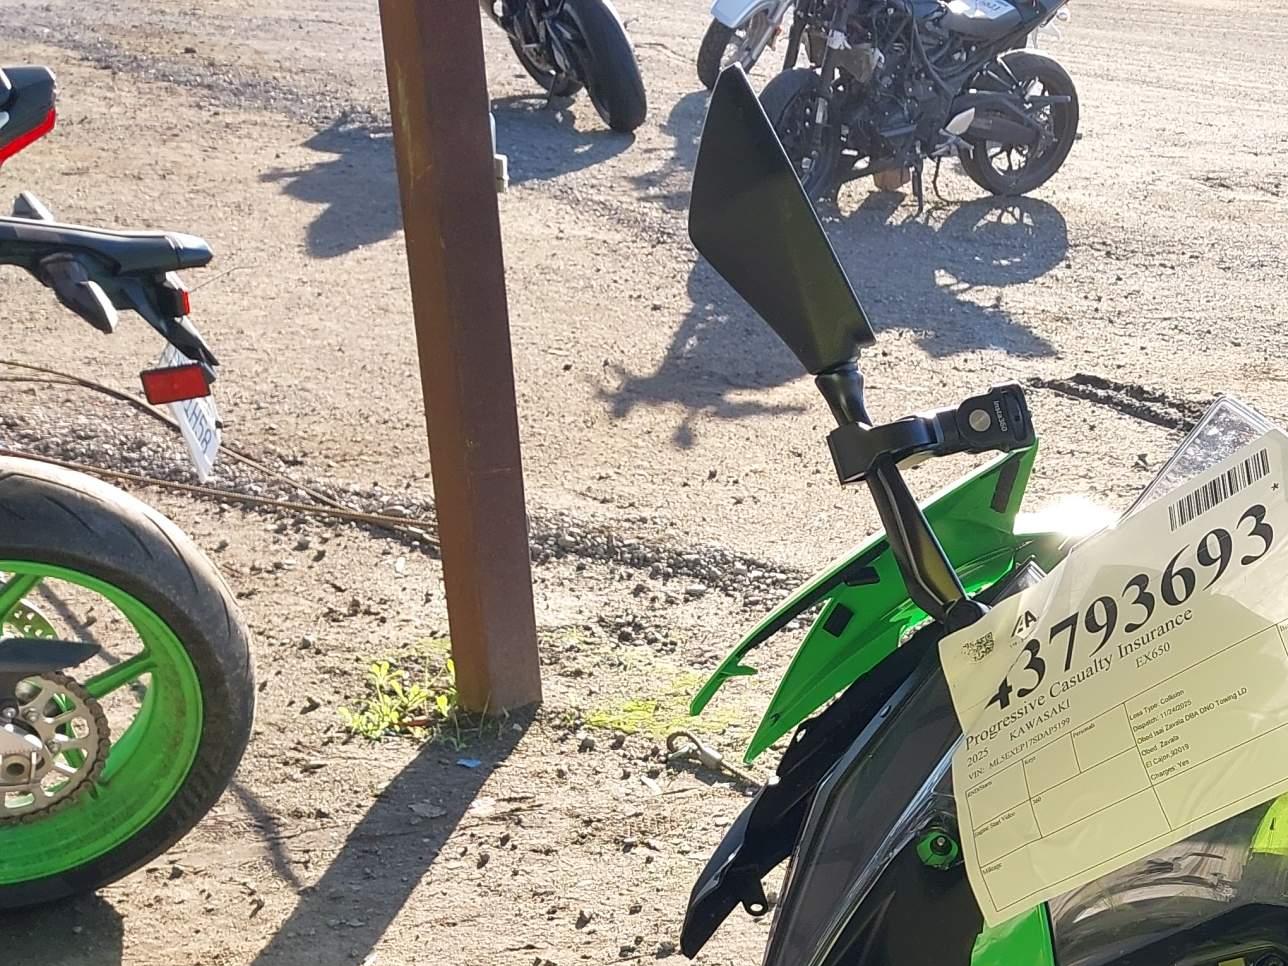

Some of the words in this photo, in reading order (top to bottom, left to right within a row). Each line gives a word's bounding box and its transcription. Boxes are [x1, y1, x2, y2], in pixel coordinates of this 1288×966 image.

[983, 503, 1274, 710] 43793693
[1136, 641, 1171, 668] EX650
[965, 695, 1045, 750] Progressive
[1049, 653, 1113, 698] Casualty
[1117, 608, 1193, 659] Insurance
[1215, 692, 1238, 707] Towing
[967, 747, 989, 767] 2025
[1009, 699, 1070, 741] KAWASAKI
[968, 767, 985, 780] VIN:
[1177, 759, 1190, 768] Yes
